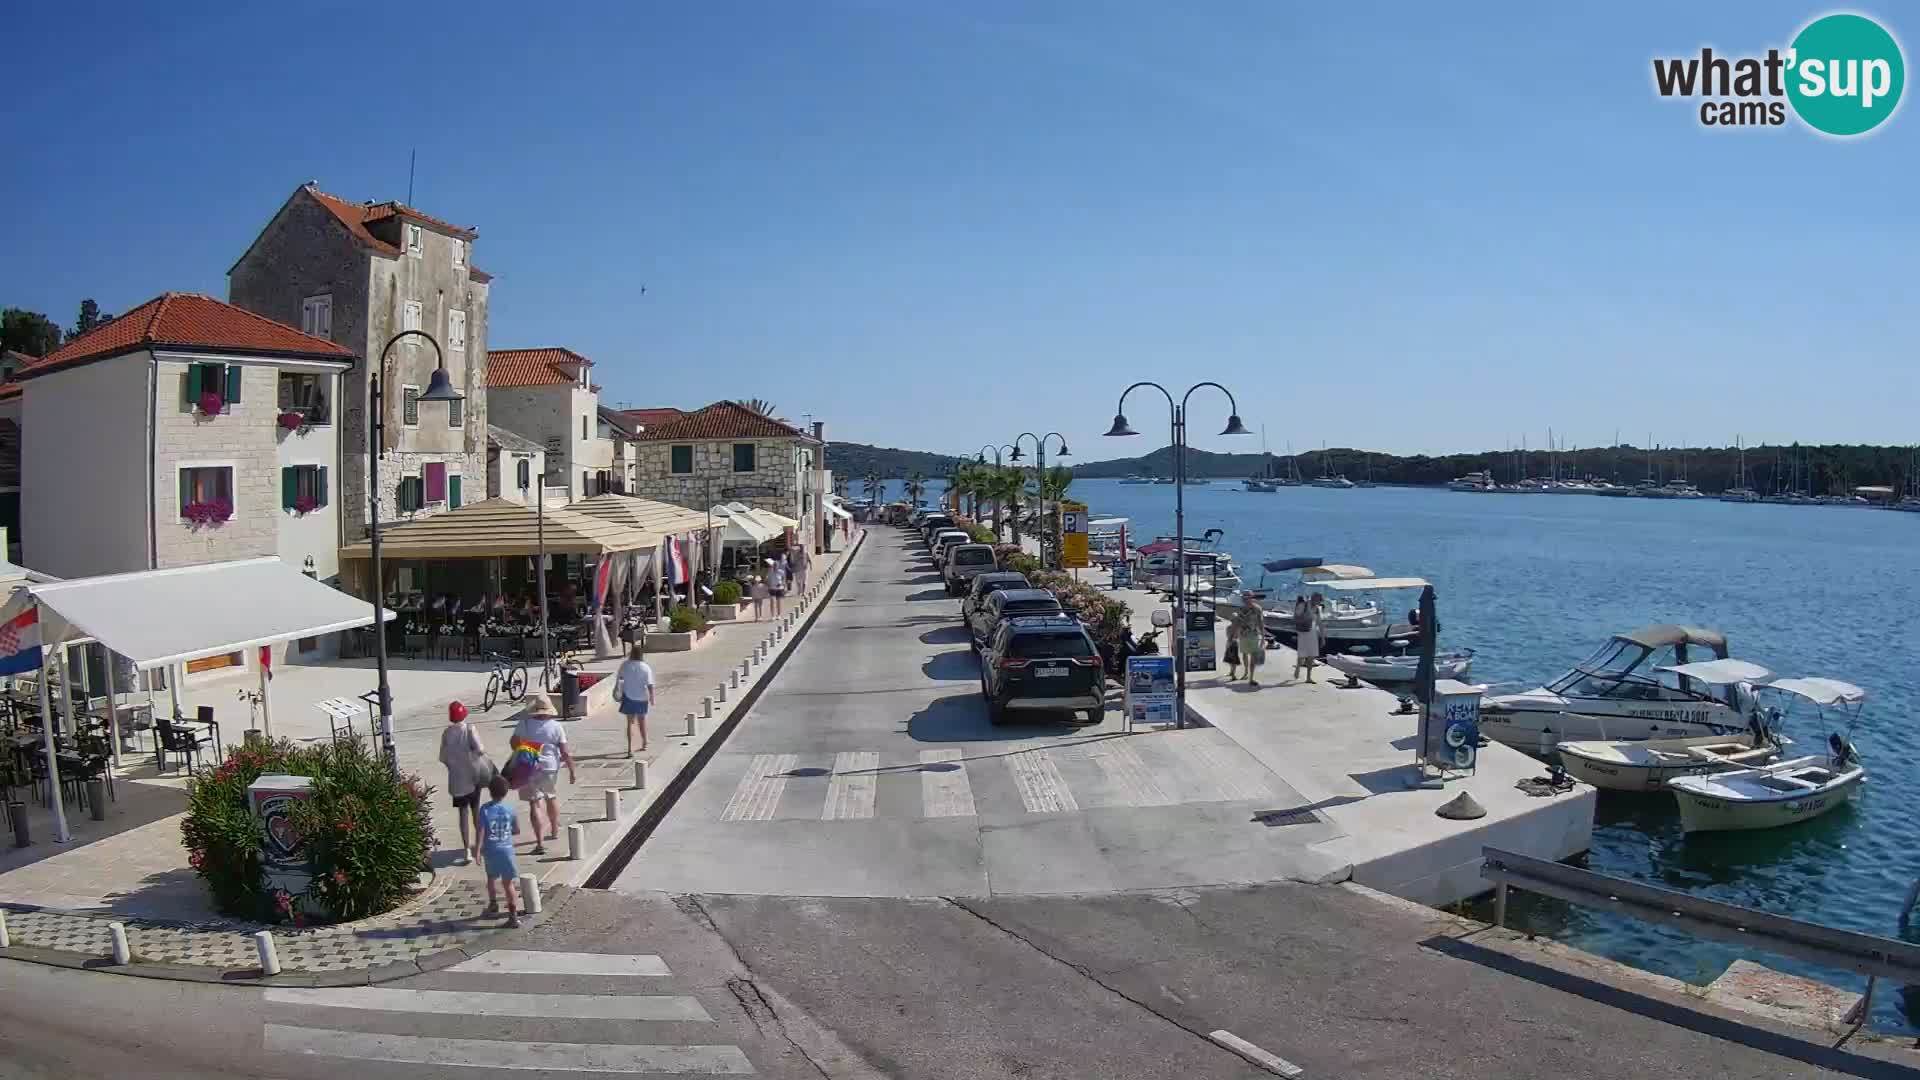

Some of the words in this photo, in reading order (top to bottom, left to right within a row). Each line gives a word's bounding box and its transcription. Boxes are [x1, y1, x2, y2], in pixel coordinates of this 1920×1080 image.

[1064, 514, 1076, 531] P
[1447, 702, 1477, 712] RENT
[1447, 711, 1454, 720] A
[1455, 711, 1477, 720] BOAT
